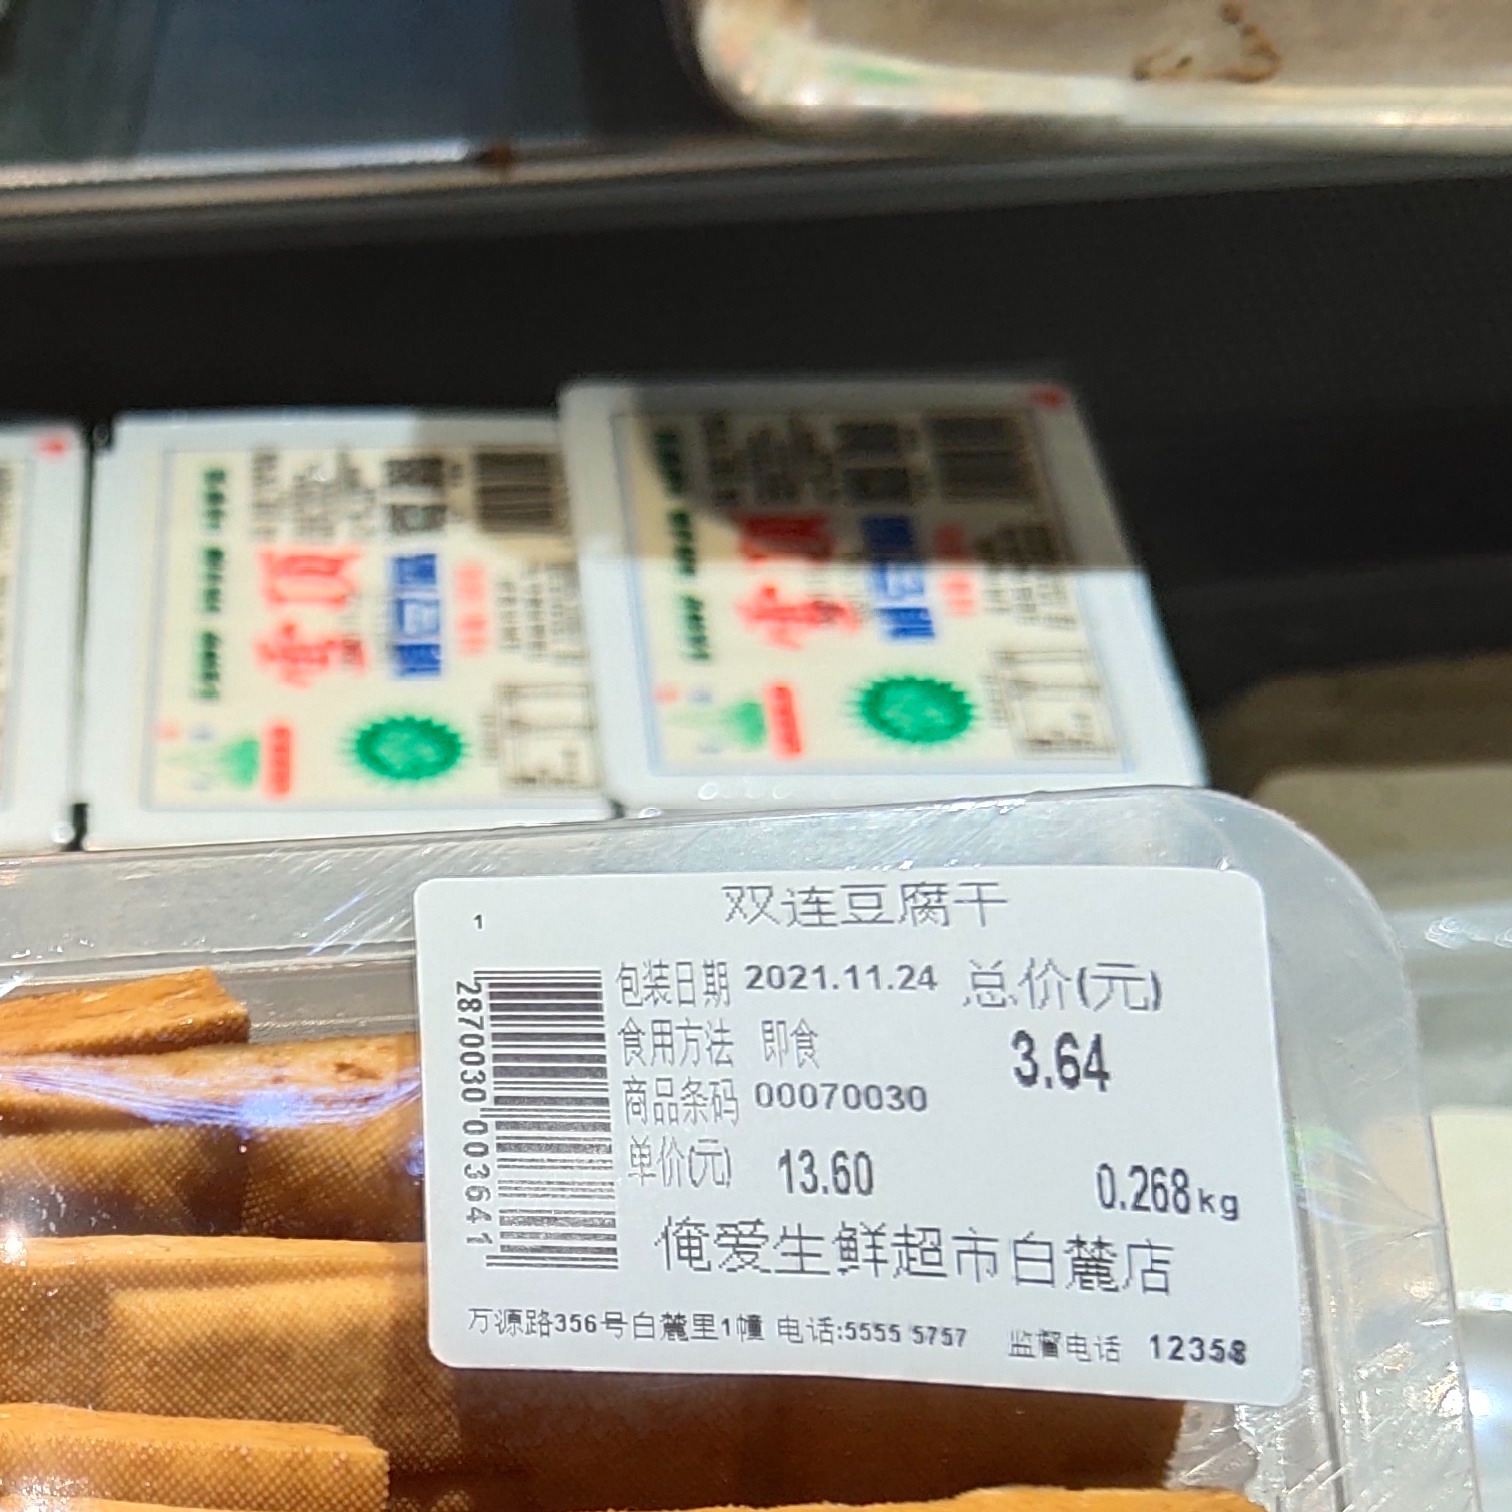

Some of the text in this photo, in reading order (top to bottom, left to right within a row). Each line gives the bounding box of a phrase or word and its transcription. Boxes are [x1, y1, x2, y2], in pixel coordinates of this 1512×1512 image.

[472, 913, 484, 930] 1
[720, 880, 1010, 930] 双连豆腐干
[616, 959, 939, 1008] 包装日期 2021.11.24
[962, 957, 1163, 1013] 总价(元)
[617, 1016, 820, 1069] 食用方法 即食
[1011, 1029, 1112, 1093] 3.64
[622, 1074, 929, 1127] 商品条码 00070030
[627, 1135, 875, 1197] 单价(元) 13.60
[653, 1213, 1177, 1297] 俺爱生鲜超市白麓店
[1008, 1328, 1247, 1366] 监督电话 12358
